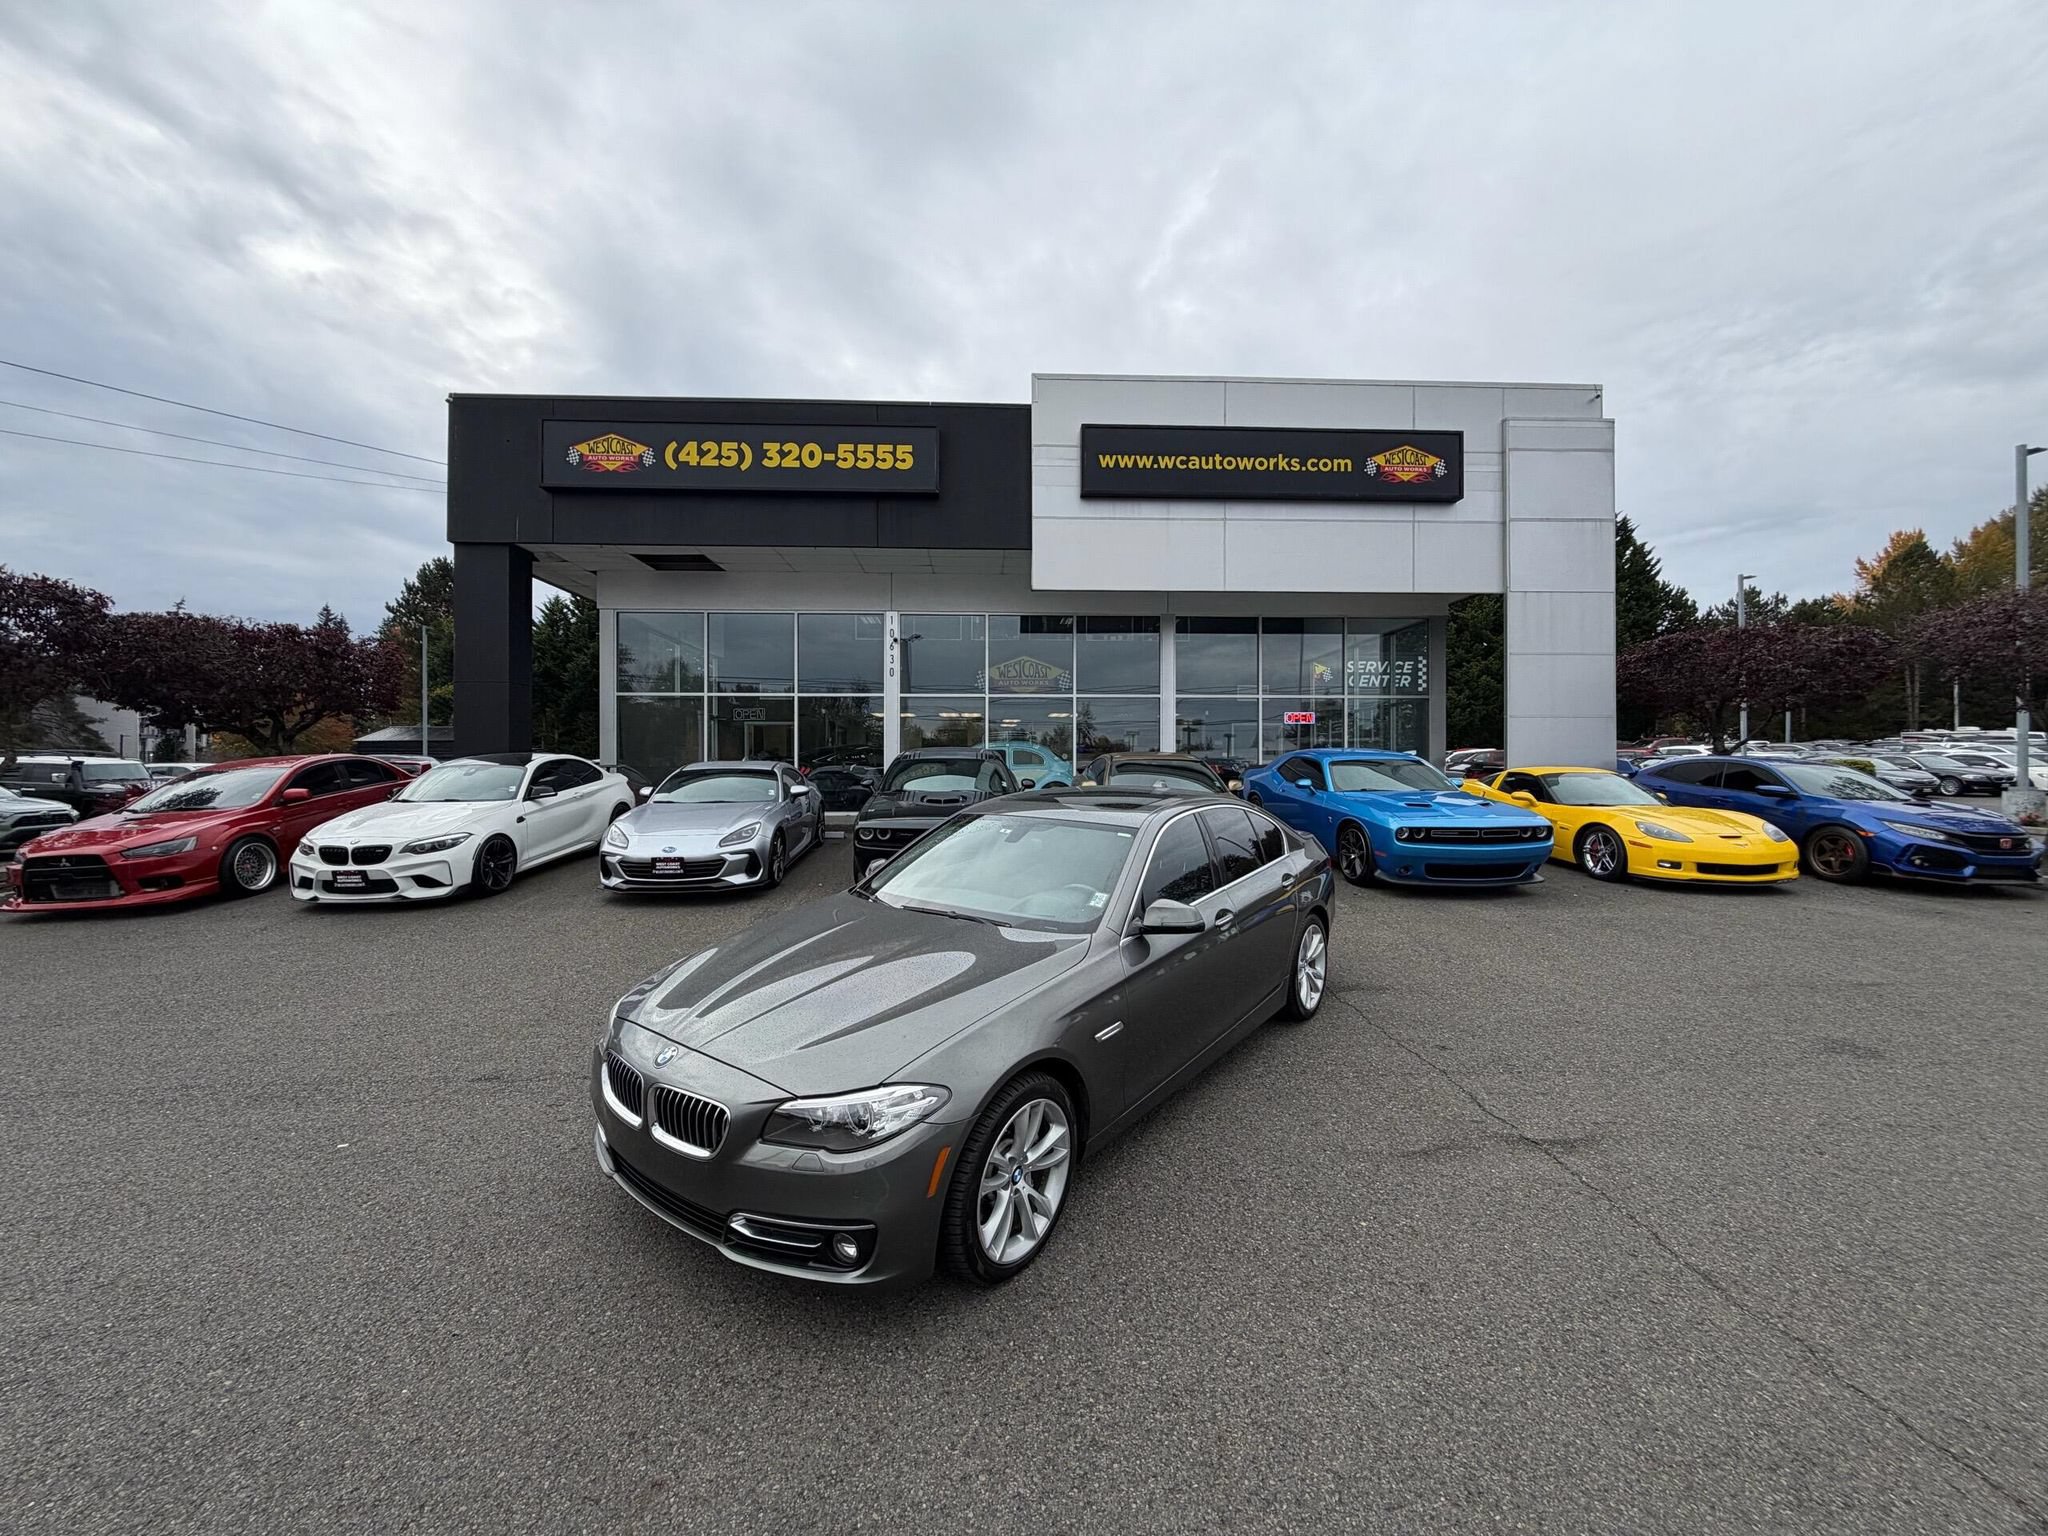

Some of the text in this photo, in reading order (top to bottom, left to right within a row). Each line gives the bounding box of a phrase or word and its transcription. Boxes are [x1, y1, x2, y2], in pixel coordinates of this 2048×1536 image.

[664, 440, 914, 472] (425) 320-5555
[1098, 453, 1353, 473] www.wcautoworks.com
[736, 709, 763, 719] OPEN
[1286, 713, 1312, 723] OPEN
